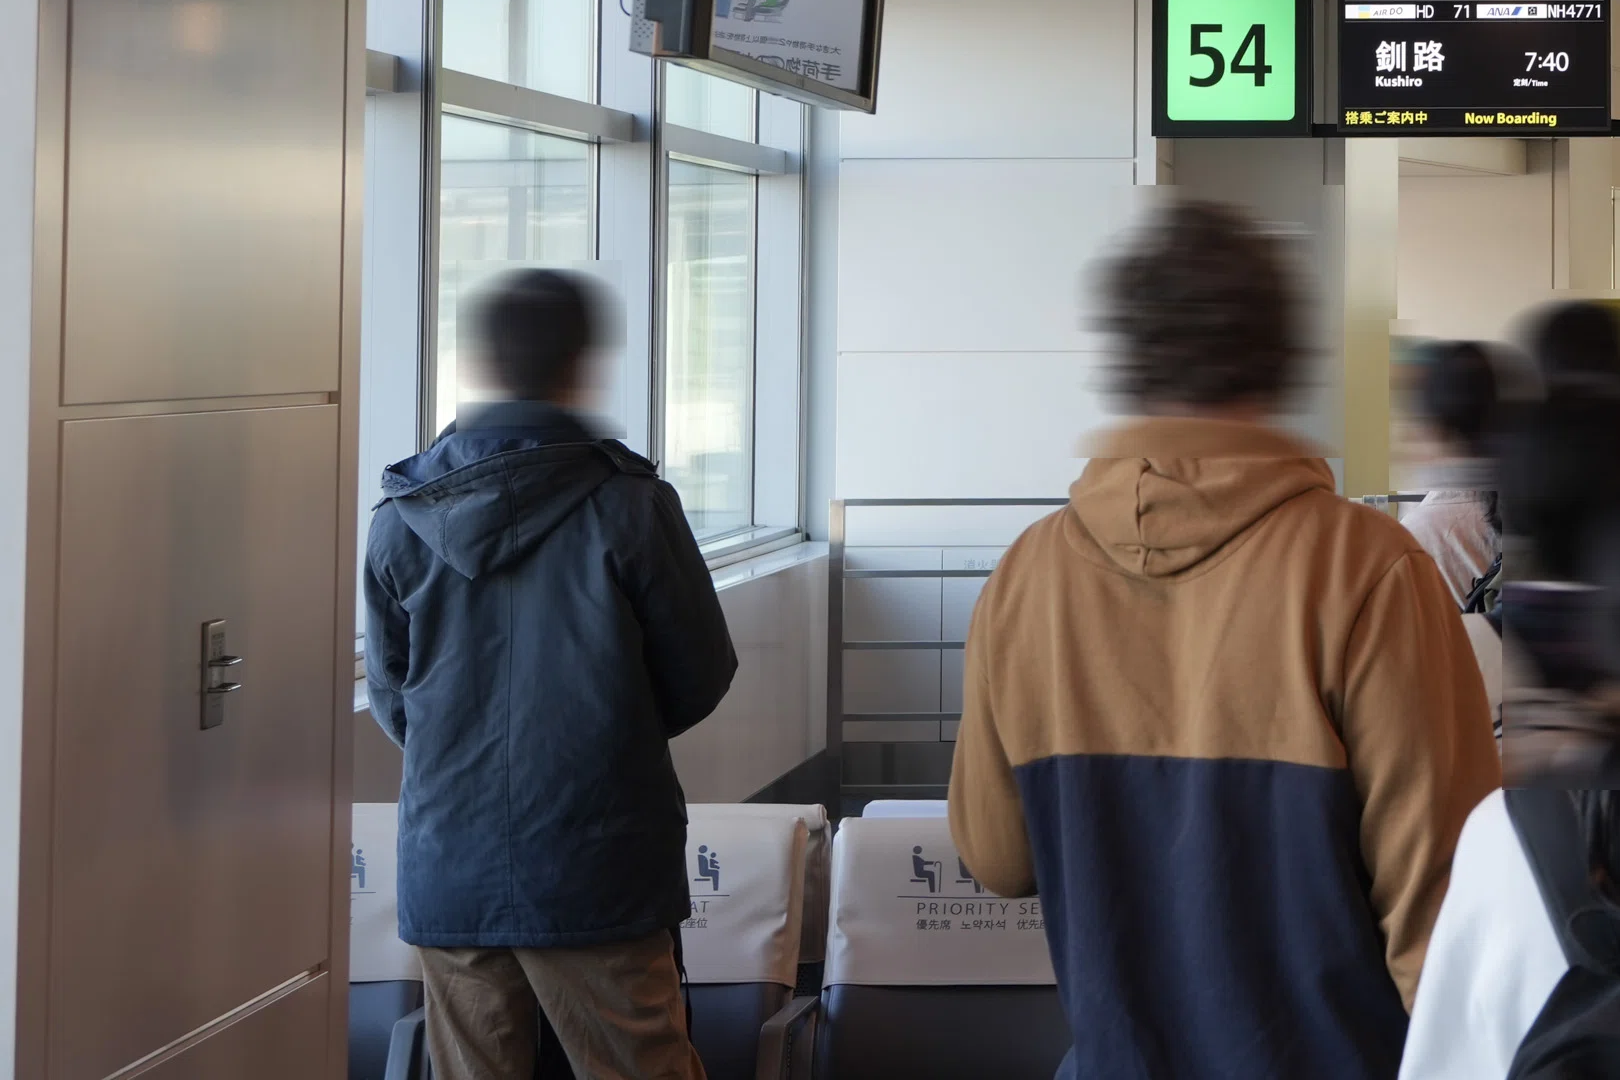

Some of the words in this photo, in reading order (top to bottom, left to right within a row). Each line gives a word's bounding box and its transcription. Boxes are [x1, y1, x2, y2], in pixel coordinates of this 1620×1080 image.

[1416, 4, 1434, 19] HD
[1453, 4, 1470, 19] 71
[1487, 7, 1510, 17] ANA
[1547, 4, 1601, 19] NH4771
[1187, 23, 1273, 88] 54
[1375, 40, 1445, 72] 釧路
[1524, 51, 1569, 72] 7:40
[1375, 75, 1423, 87] Kushiro
[1345, 110, 1428, 125] 搭乗ご案内中
[1464, 112, 1494, 124] Now
[1497, 112, 1557, 127] Boarding
[916, 902, 1009, 915] PRIORITY
[1019, 902, 1039, 915] SE
[916, 919, 951, 930] 優先席
[960, 920, 1006, 930] 노약자석
[1016, 919, 1046, 930] 优先
